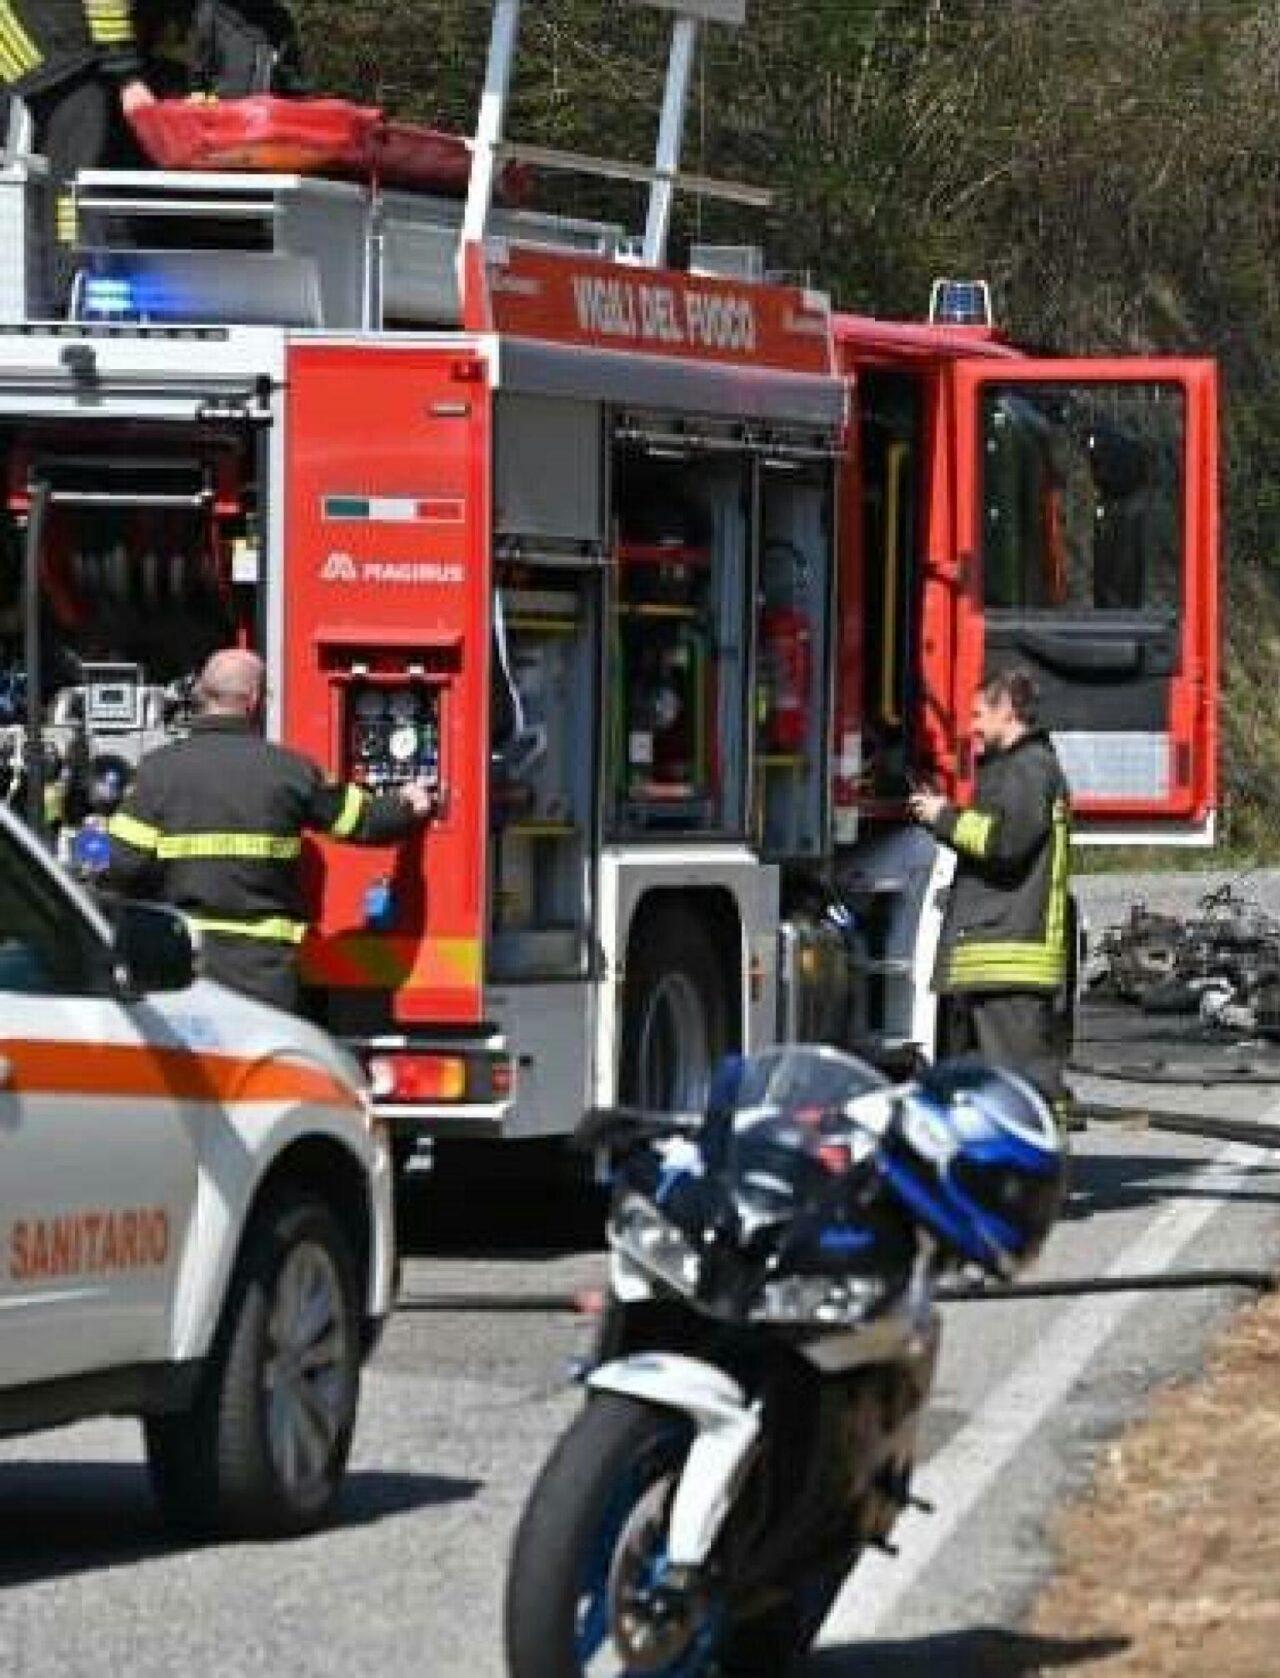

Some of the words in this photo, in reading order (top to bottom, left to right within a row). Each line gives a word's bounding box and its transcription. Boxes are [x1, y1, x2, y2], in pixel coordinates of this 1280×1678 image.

[573, 275, 636, 337] VIGILI
[640, 284, 683, 341] DEL
[684, 290, 755, 351] FUOCO
[362, 563, 465, 583] MAGIRUS
[9, 1206, 169, 1279] SANITARIO
